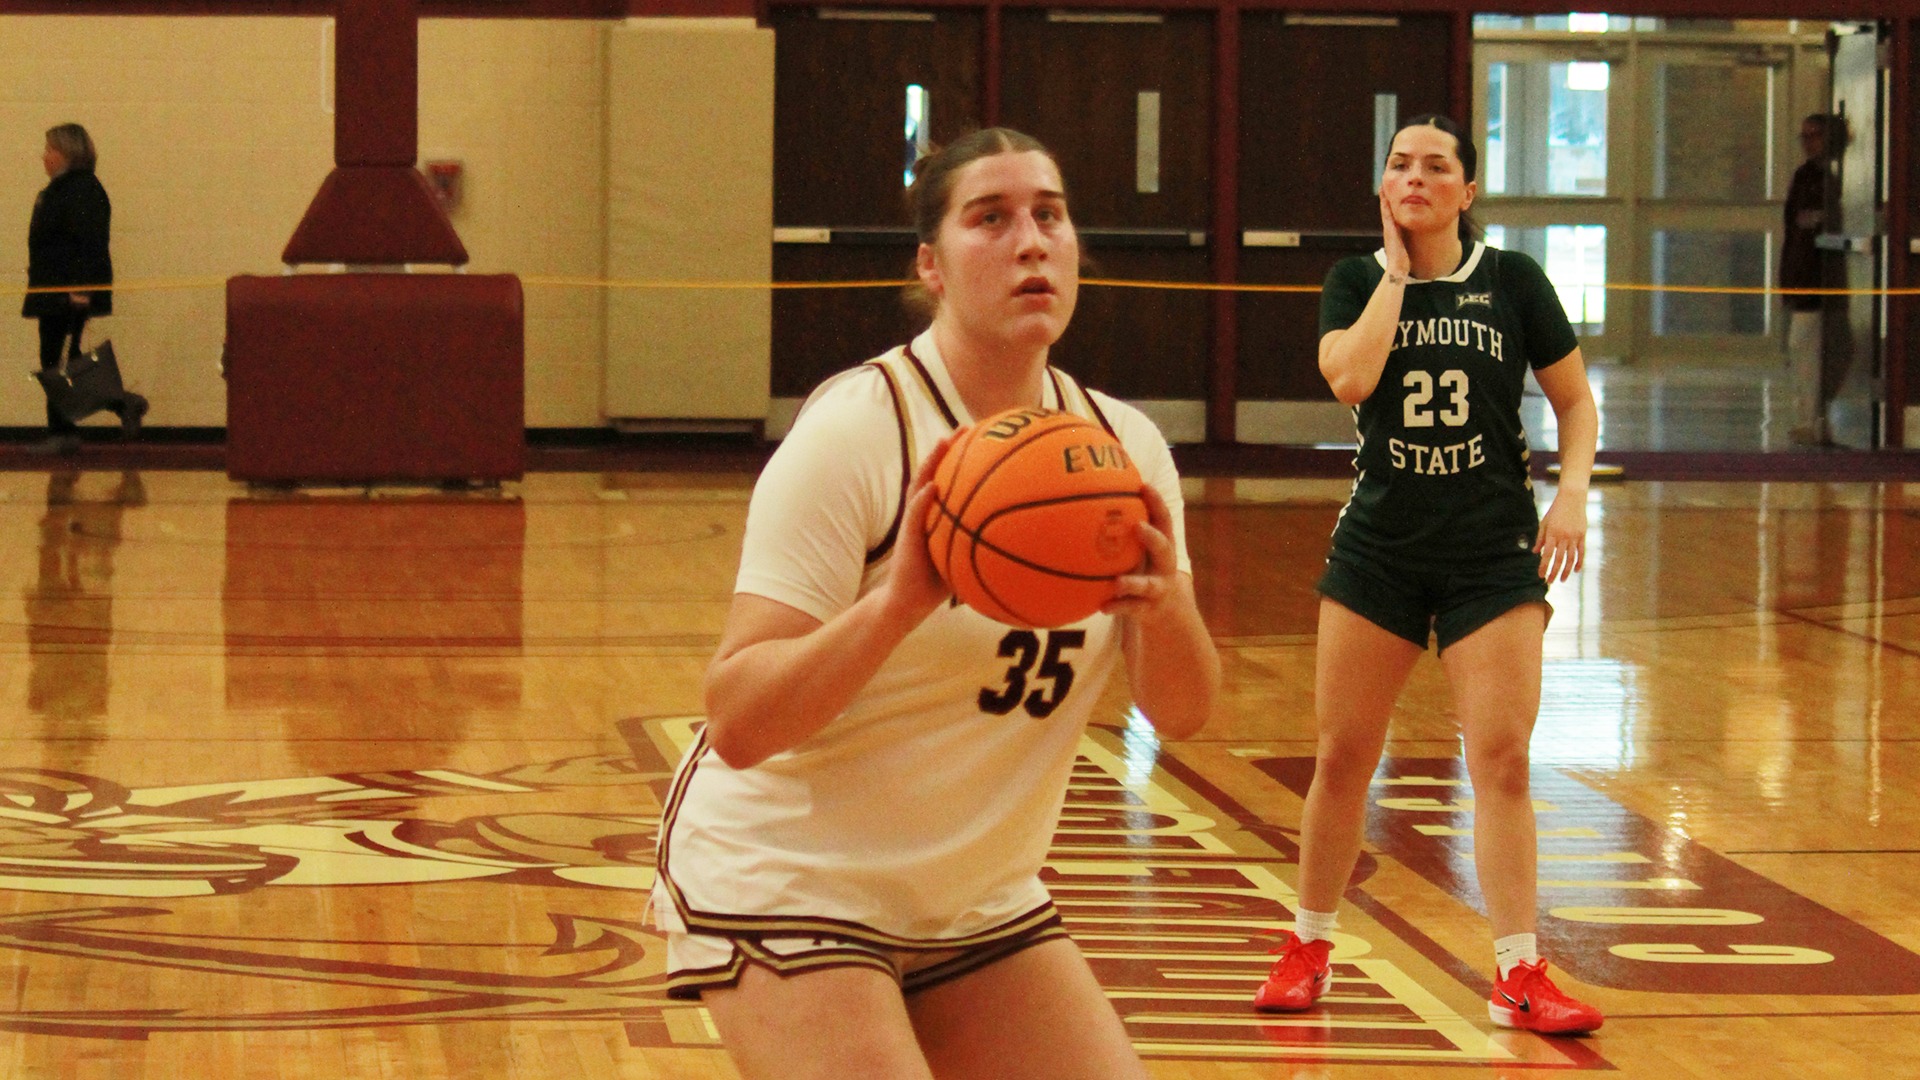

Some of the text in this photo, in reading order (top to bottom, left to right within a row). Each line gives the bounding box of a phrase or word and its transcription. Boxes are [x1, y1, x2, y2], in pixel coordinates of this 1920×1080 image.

[1391, 316, 1504, 362] YMOUTH
[1402, 369, 1470, 428] 23
[1388, 433, 1486, 475] STATE
[977, 629, 1087, 718] 35
